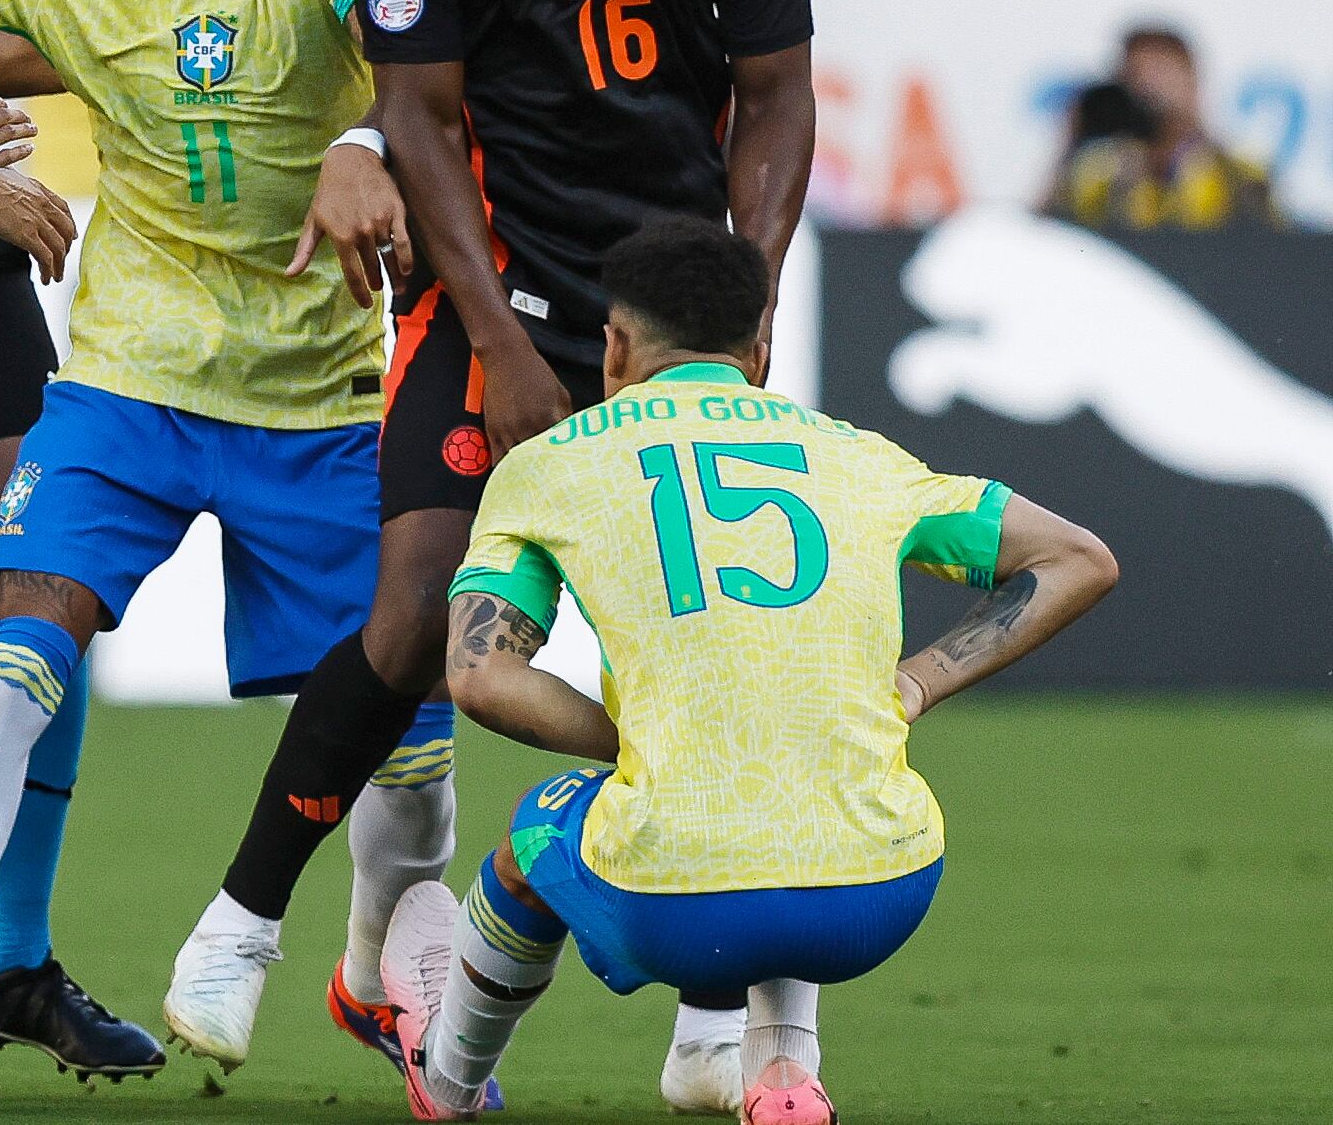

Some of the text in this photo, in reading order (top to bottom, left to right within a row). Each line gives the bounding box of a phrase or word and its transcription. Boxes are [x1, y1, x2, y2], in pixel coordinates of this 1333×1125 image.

[193, 44, 218, 56] CBF
[174, 90, 239, 106] BRASIL
[181, 122, 239, 204] 11
[638, 441, 829, 618] 15
